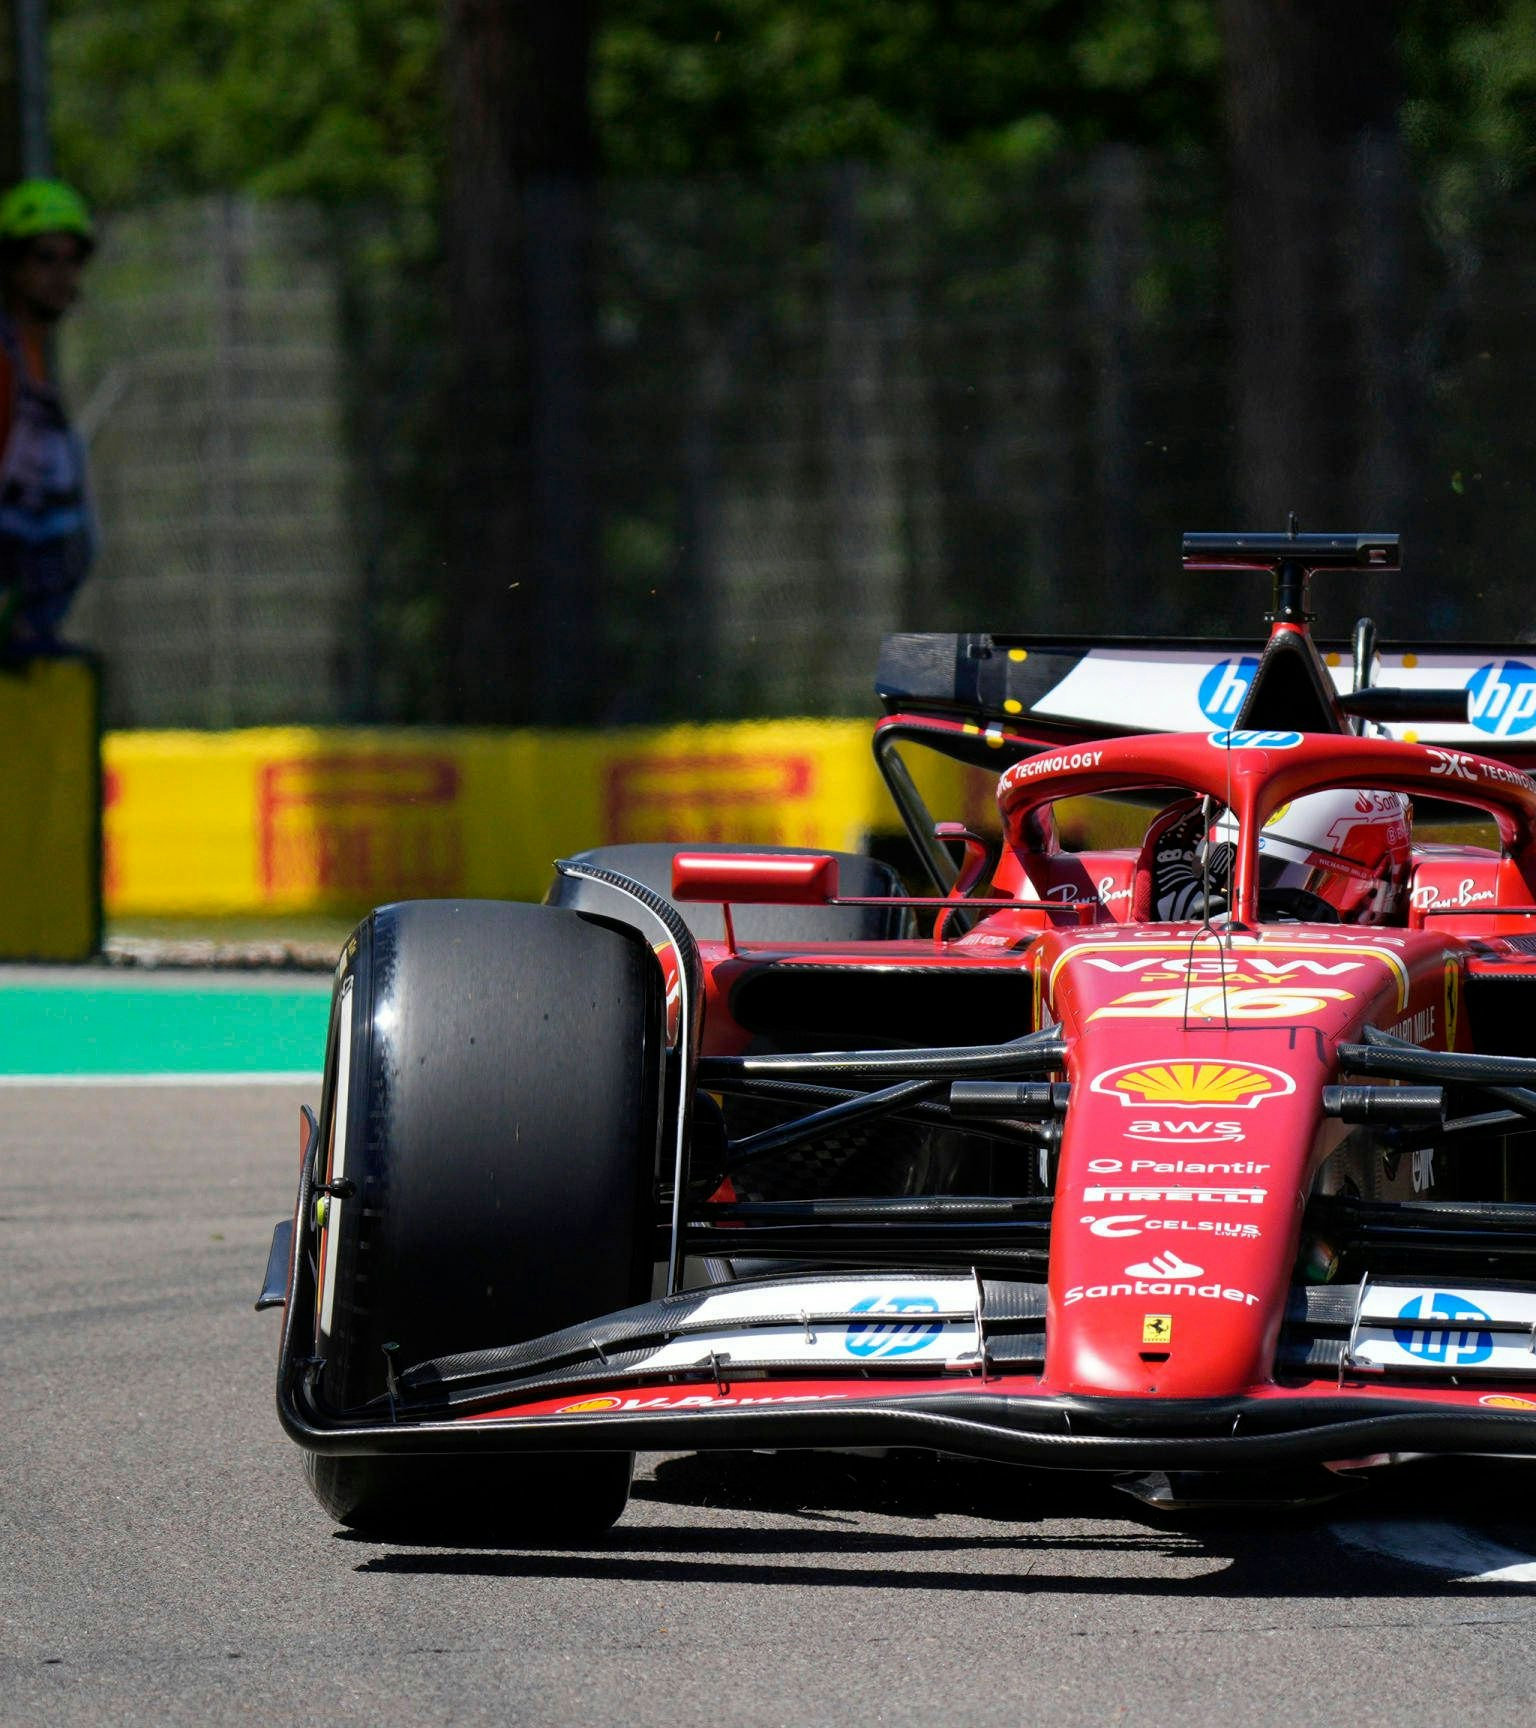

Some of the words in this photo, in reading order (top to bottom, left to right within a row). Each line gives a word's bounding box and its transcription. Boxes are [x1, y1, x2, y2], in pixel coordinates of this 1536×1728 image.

[1205, 657, 1248, 731] h
[1016, 752, 1102, 779] TECHNOLOGY
[1426, 749, 1478, 781] DXC
[1410, 879, 1495, 908] Ray-Ban
[1082, 957, 1366, 975] VGW
[1140, 971, 1300, 985] PLAY
[1085, 985, 1355, 1023] 16
[1128, 1120, 1242, 1134] aws
[1131, 1160, 1271, 1174] Palantir
[1083, 1187, 1268, 1204] PIRELLI
[1145, 1220, 1260, 1235] CELSIUS
[1064, 1281, 1259, 1306] Santander
[1403, 1292, 1489, 1364] hp
